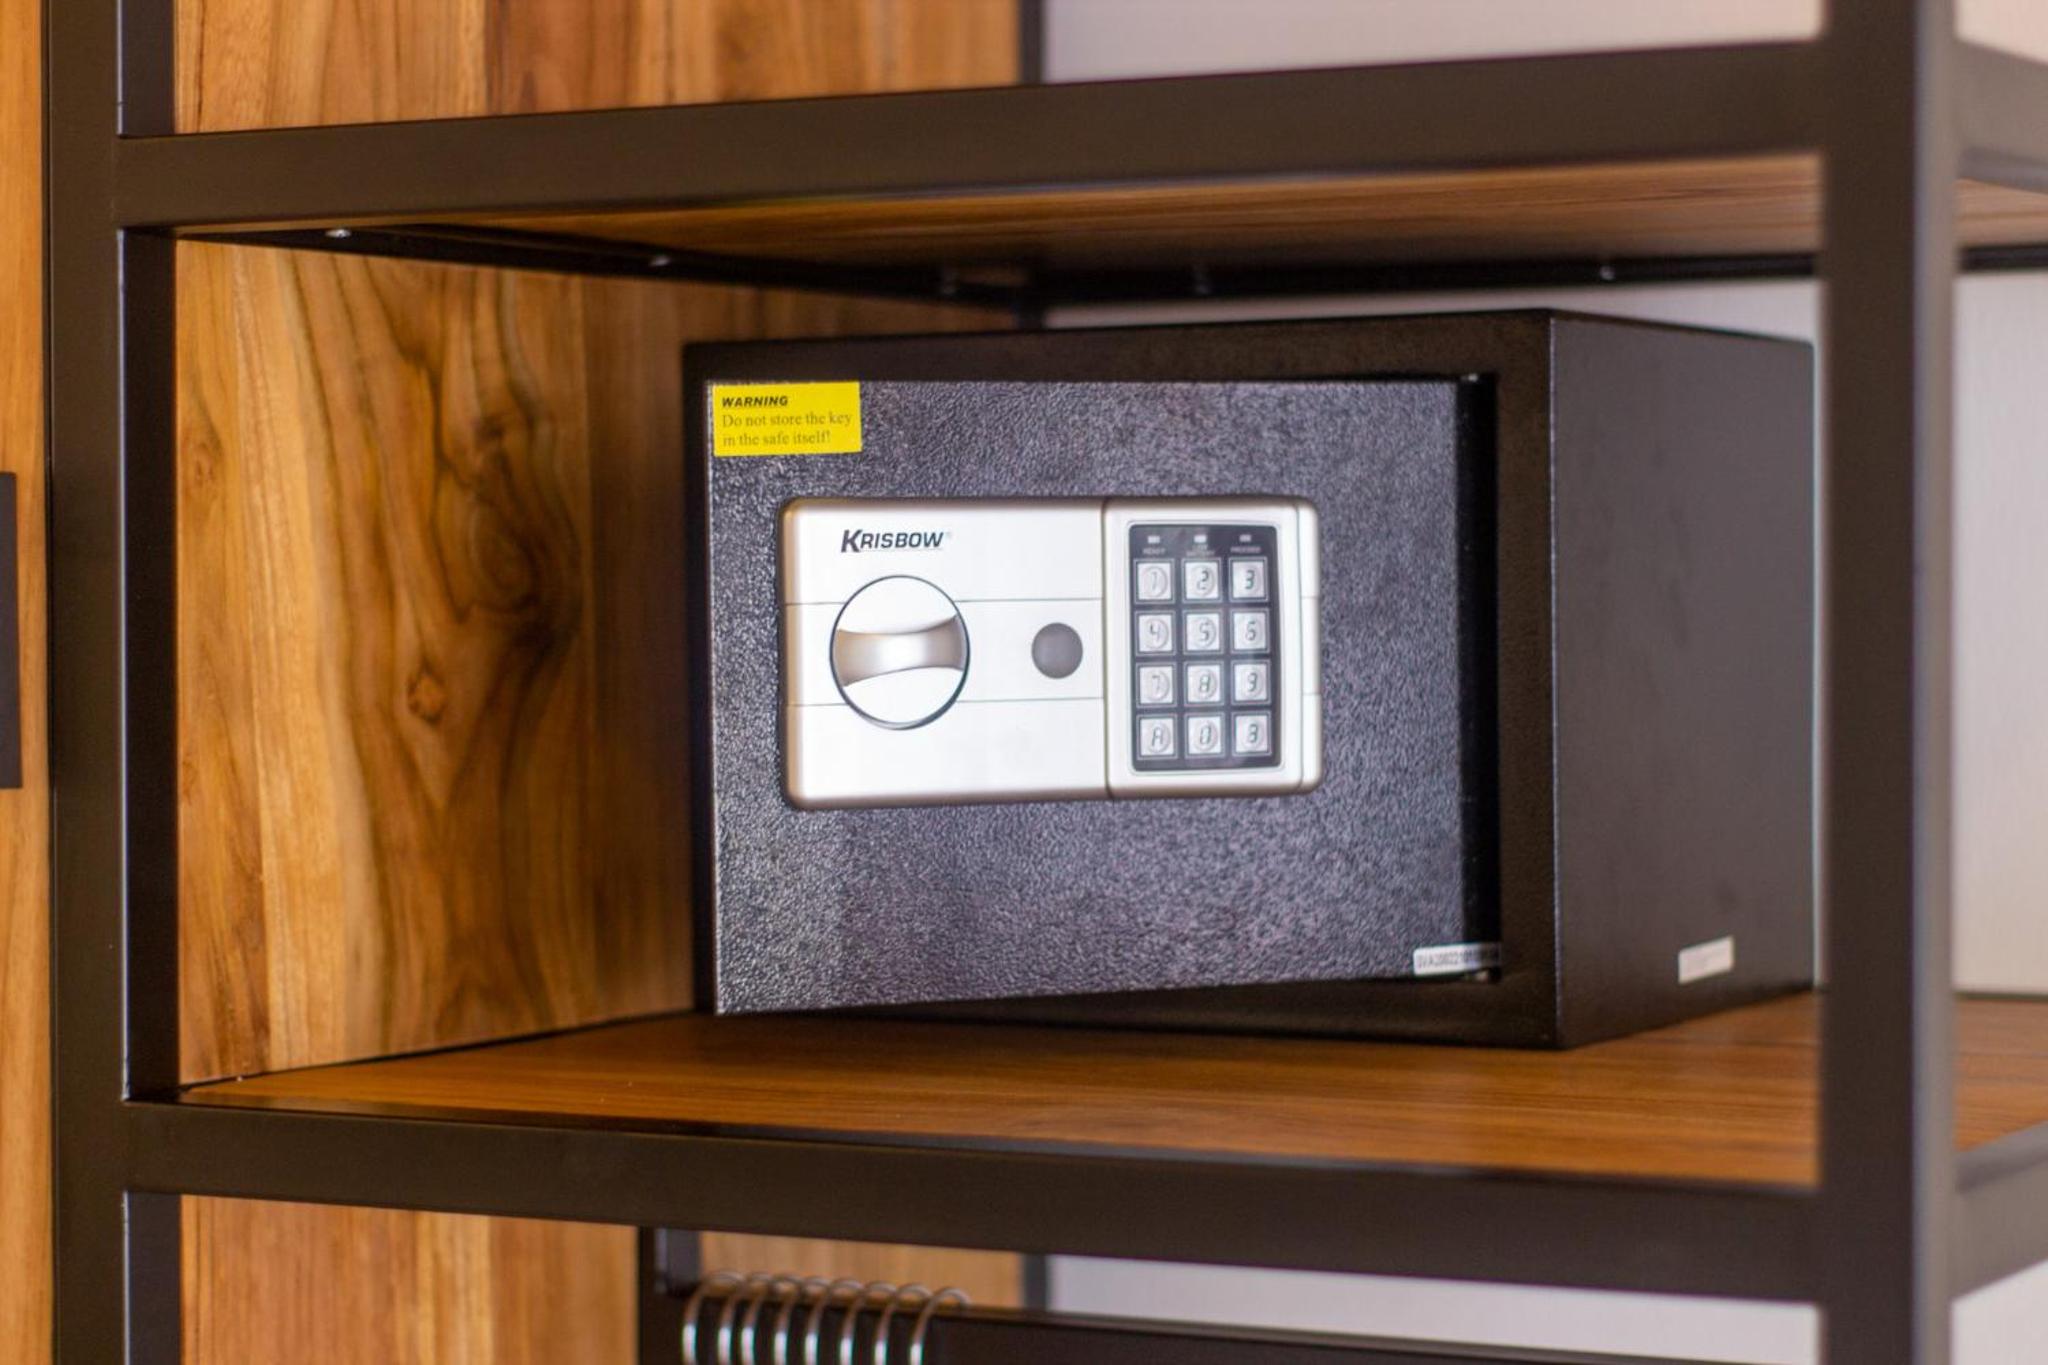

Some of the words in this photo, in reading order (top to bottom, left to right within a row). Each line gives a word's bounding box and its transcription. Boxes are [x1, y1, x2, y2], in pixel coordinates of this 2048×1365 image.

[722, 395, 789, 408] WARNING
[722, 414, 742, 428] Do
[745, 414, 767, 427] not
[770, 413, 802, 426] store
[805, 411, 825, 425] the
[828, 411, 853, 428] key
[723, 434, 735, 447] in
[739, 433, 759, 446] the
[763, 431, 789, 445] safe
[793, 429, 831, 445] itself!
[840, 528, 945, 554] KRISBOW
[1196, 570, 1209, 590] 2
[1245, 569, 1256, 590] 3
[1150, 623, 1161, 641] 4
[1199, 621, 1210, 642] 5
[1245, 621, 1256, 641] 6
[1151, 674, 1161, 694] 7
[1151, 726, 1163, 747] A
[1199, 725, 1212, 745] 0
